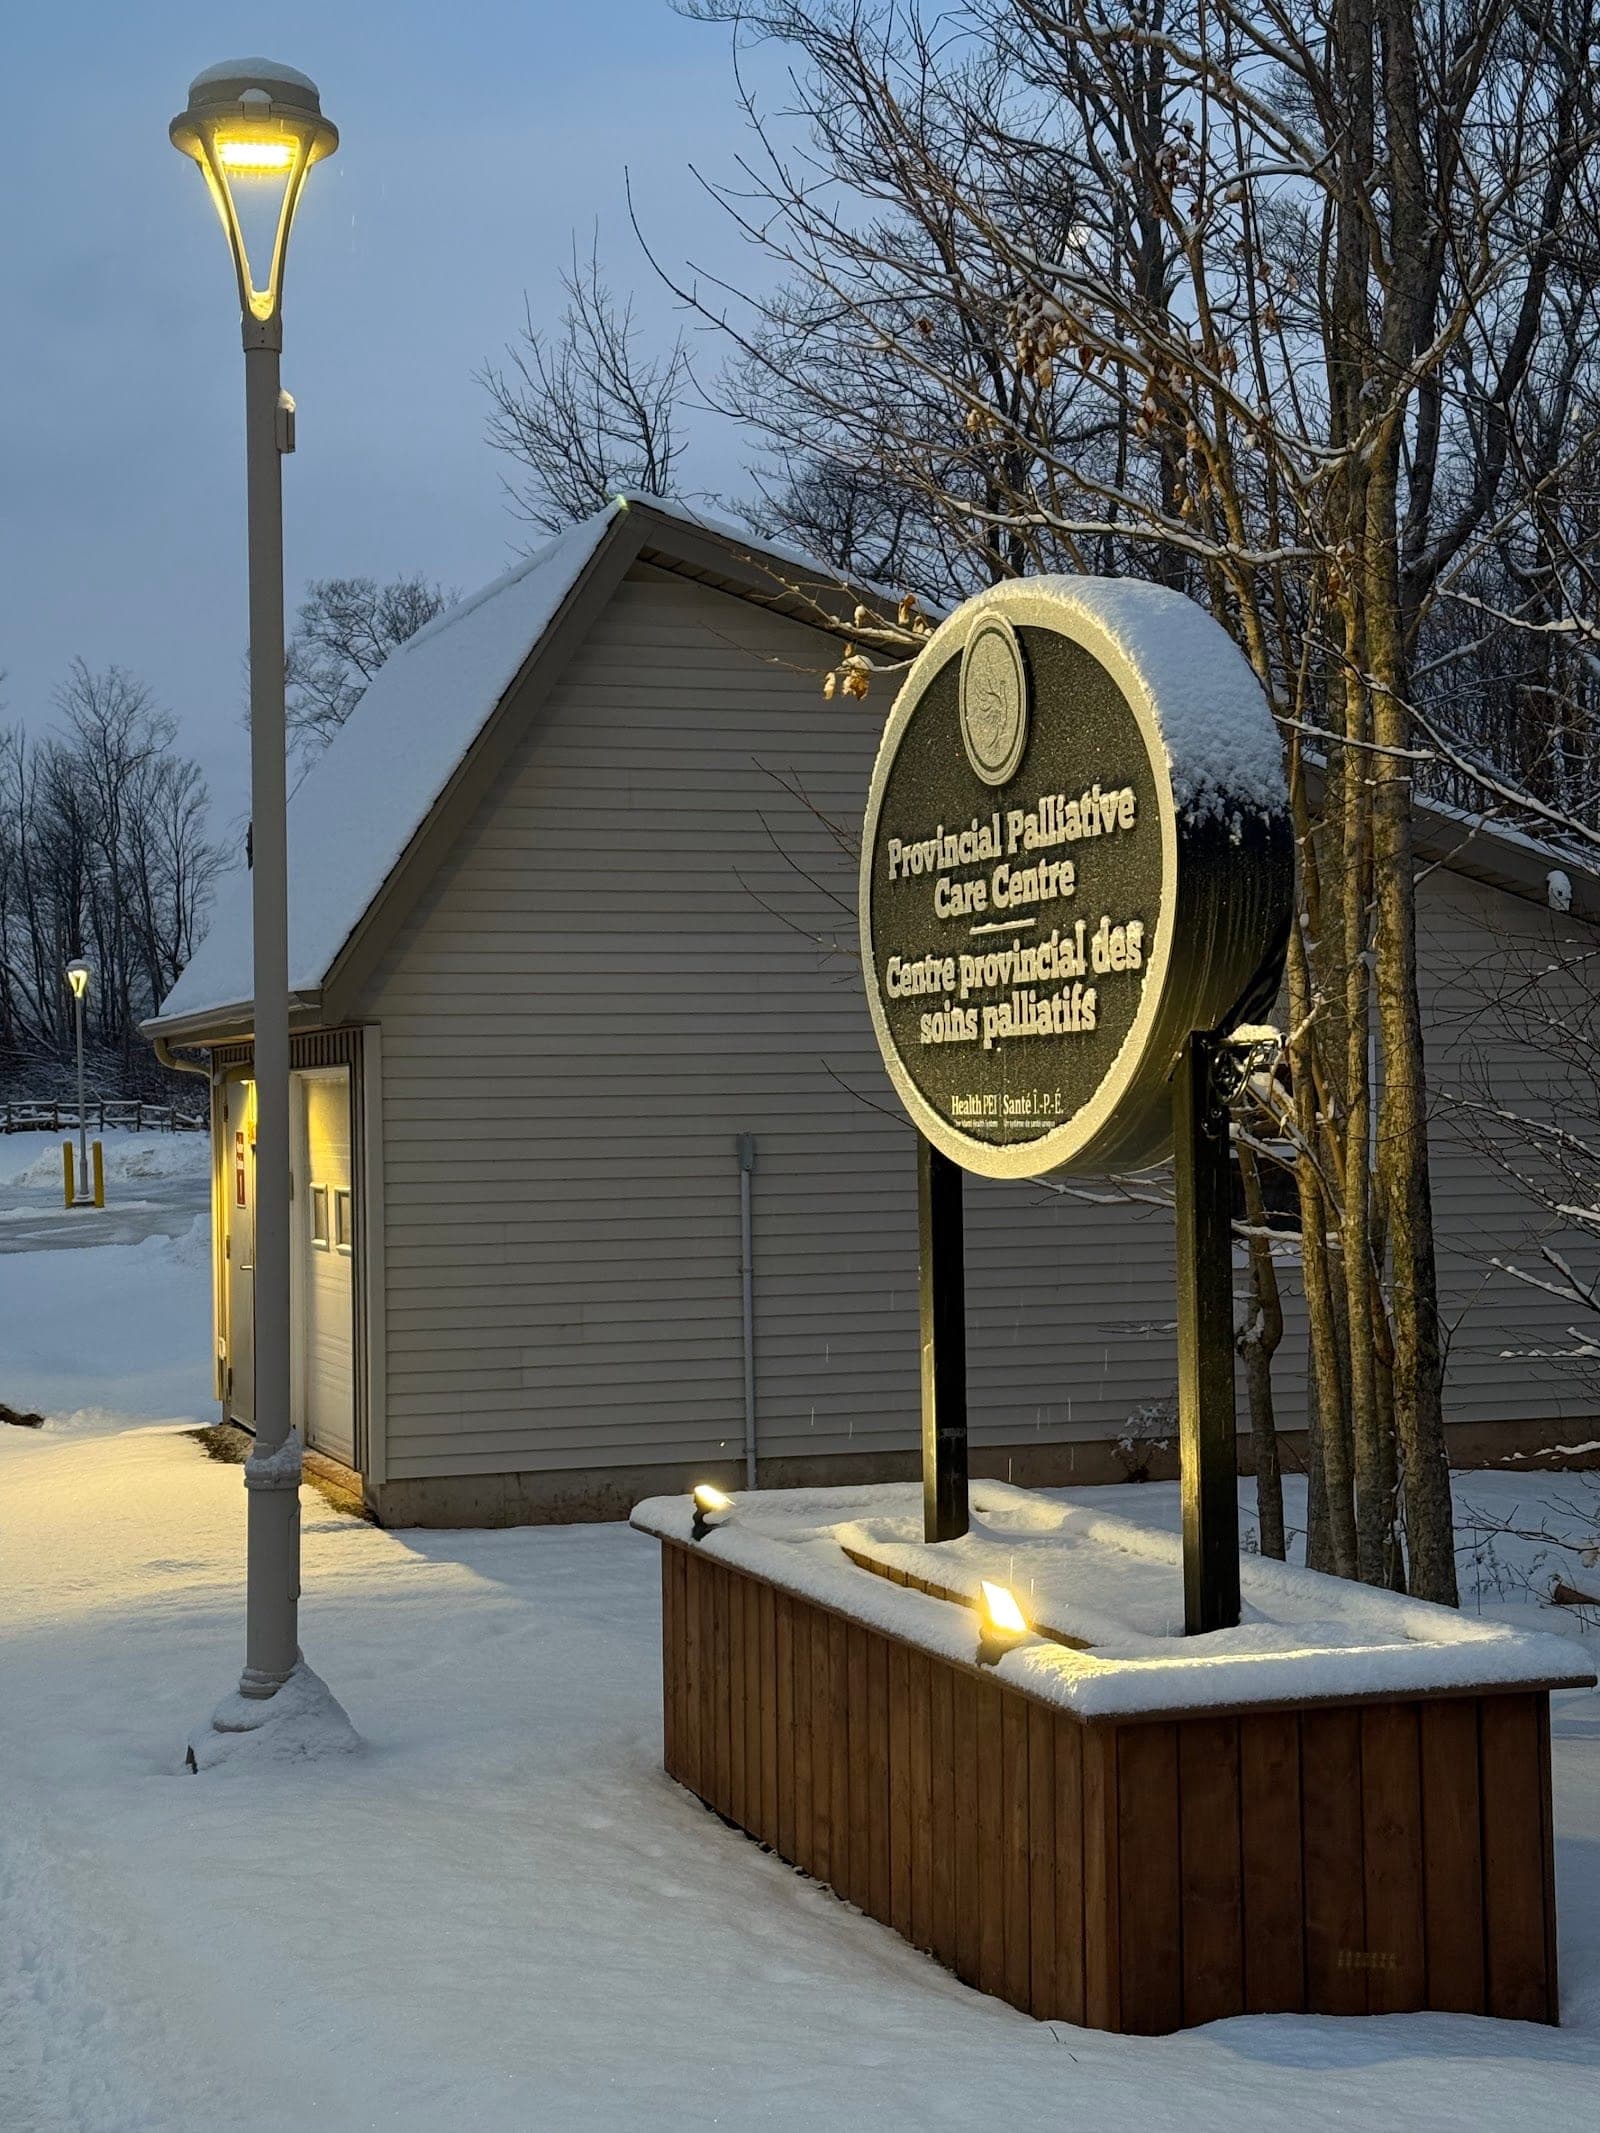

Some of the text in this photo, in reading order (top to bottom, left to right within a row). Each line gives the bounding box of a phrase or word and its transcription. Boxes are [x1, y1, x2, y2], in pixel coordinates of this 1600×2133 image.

[888, 784, 1135, 880] Provincial Palliative
[935, 859, 1076, 918] Care Centre
[886, 915, 1144, 999] Centre provincial des
[920, 981, 1098, 1049] soins palliatifs
[951, 1093, 982, 1116] Health
[983, 1094, 997, 1116] PEI
[1003, 1092, 1031, 1115] Santé
